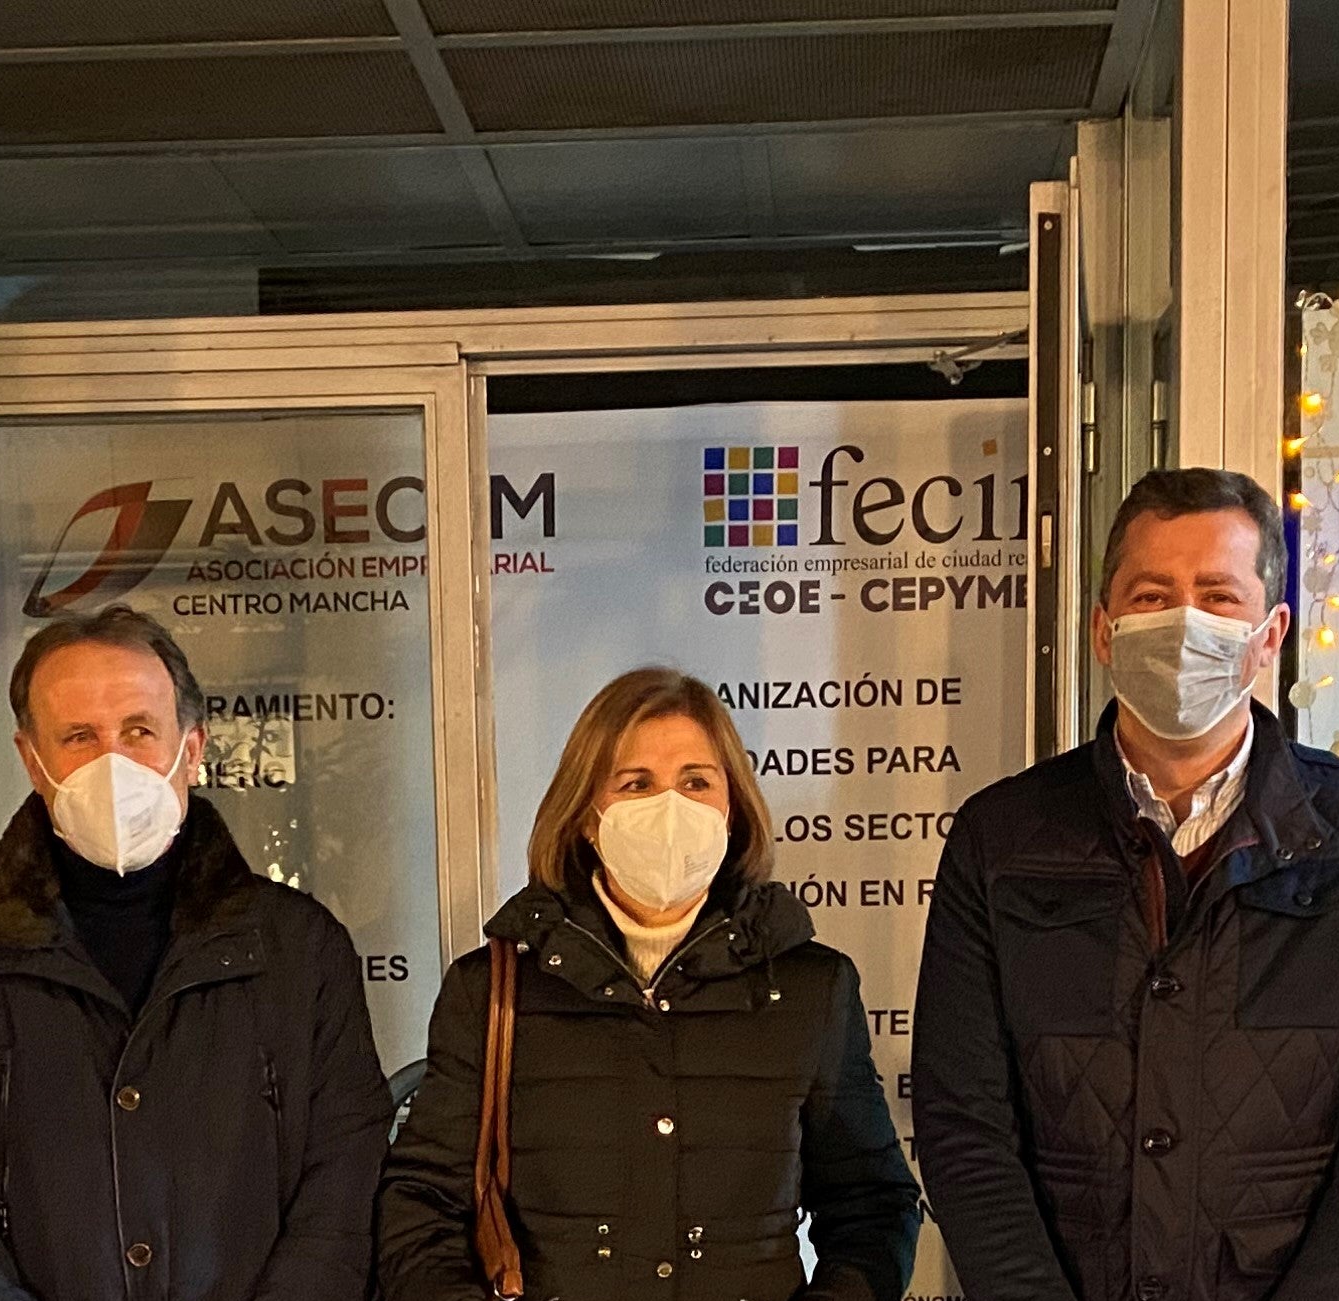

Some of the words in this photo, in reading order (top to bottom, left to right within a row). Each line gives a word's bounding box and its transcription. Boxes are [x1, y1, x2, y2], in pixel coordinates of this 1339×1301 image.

[198, 472, 555, 547] ASECM
[187, 552, 355, 582] ASOCIACIÓN
[704, 553, 798, 574] federación
[804, 551, 909, 576] empresarial
[915, 550, 937, 569] de
[942, 549, 1002, 568] ciudad
[173, 591, 282, 616] CENTRO
[290, 590, 410, 614] MANCHA
[703, 579, 821, 616] CEOE
[717, 673, 902, 710] ANIZACIÓN
[916, 677, 962, 705] DE
[866, 745, 962, 775] PARA
[774, 814, 832, 842] OS
[860, 879, 904, 906] EN
